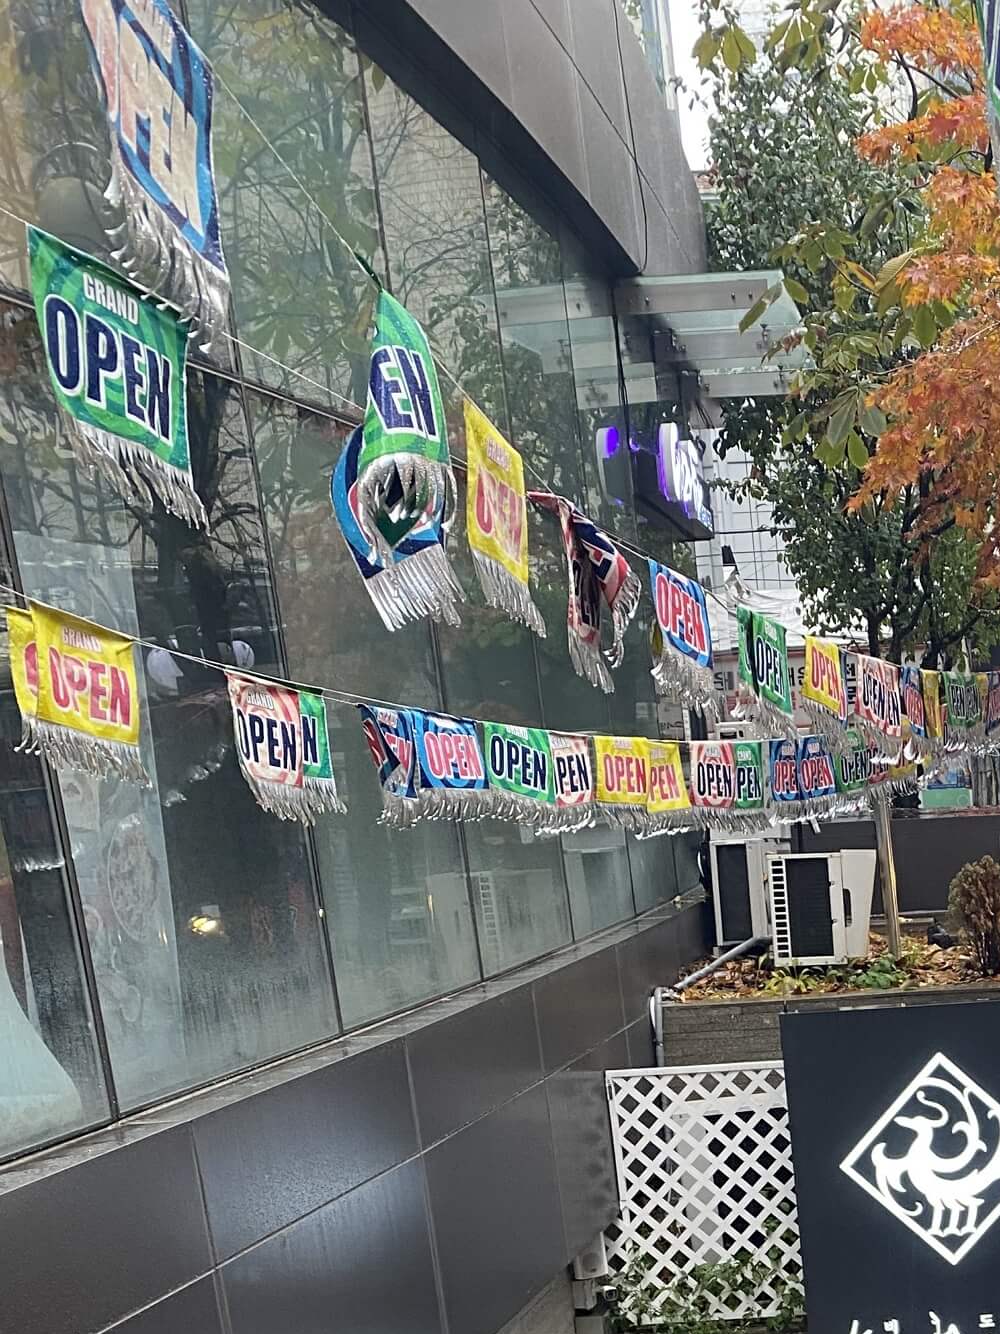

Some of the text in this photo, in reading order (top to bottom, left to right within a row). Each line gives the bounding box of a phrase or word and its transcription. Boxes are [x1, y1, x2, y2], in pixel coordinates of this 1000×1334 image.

[83, 272, 138, 325] GRAND
[43, 294, 173, 447] OPEN
[369, 344, 439, 442] EN
[62, 625, 102, 653] GRAND
[655, 572, 709, 656] OPEN
[48, 644, 133, 729] OPEN
[811, 644, 841, 705] OPEN
[234, 705, 299, 773] OPEN
[423, 730, 486, 780] OPEN
[490, 733, 548, 796] OPEN
[602, 752, 647, 794] OPEN
[649, 763, 681, 802] PEN
[696, 760, 734, 799] OPEN
[736, 765, 762, 800] PEN
[773, 759, 799, 795] OPE
[800, 755, 834, 793] OPEN
